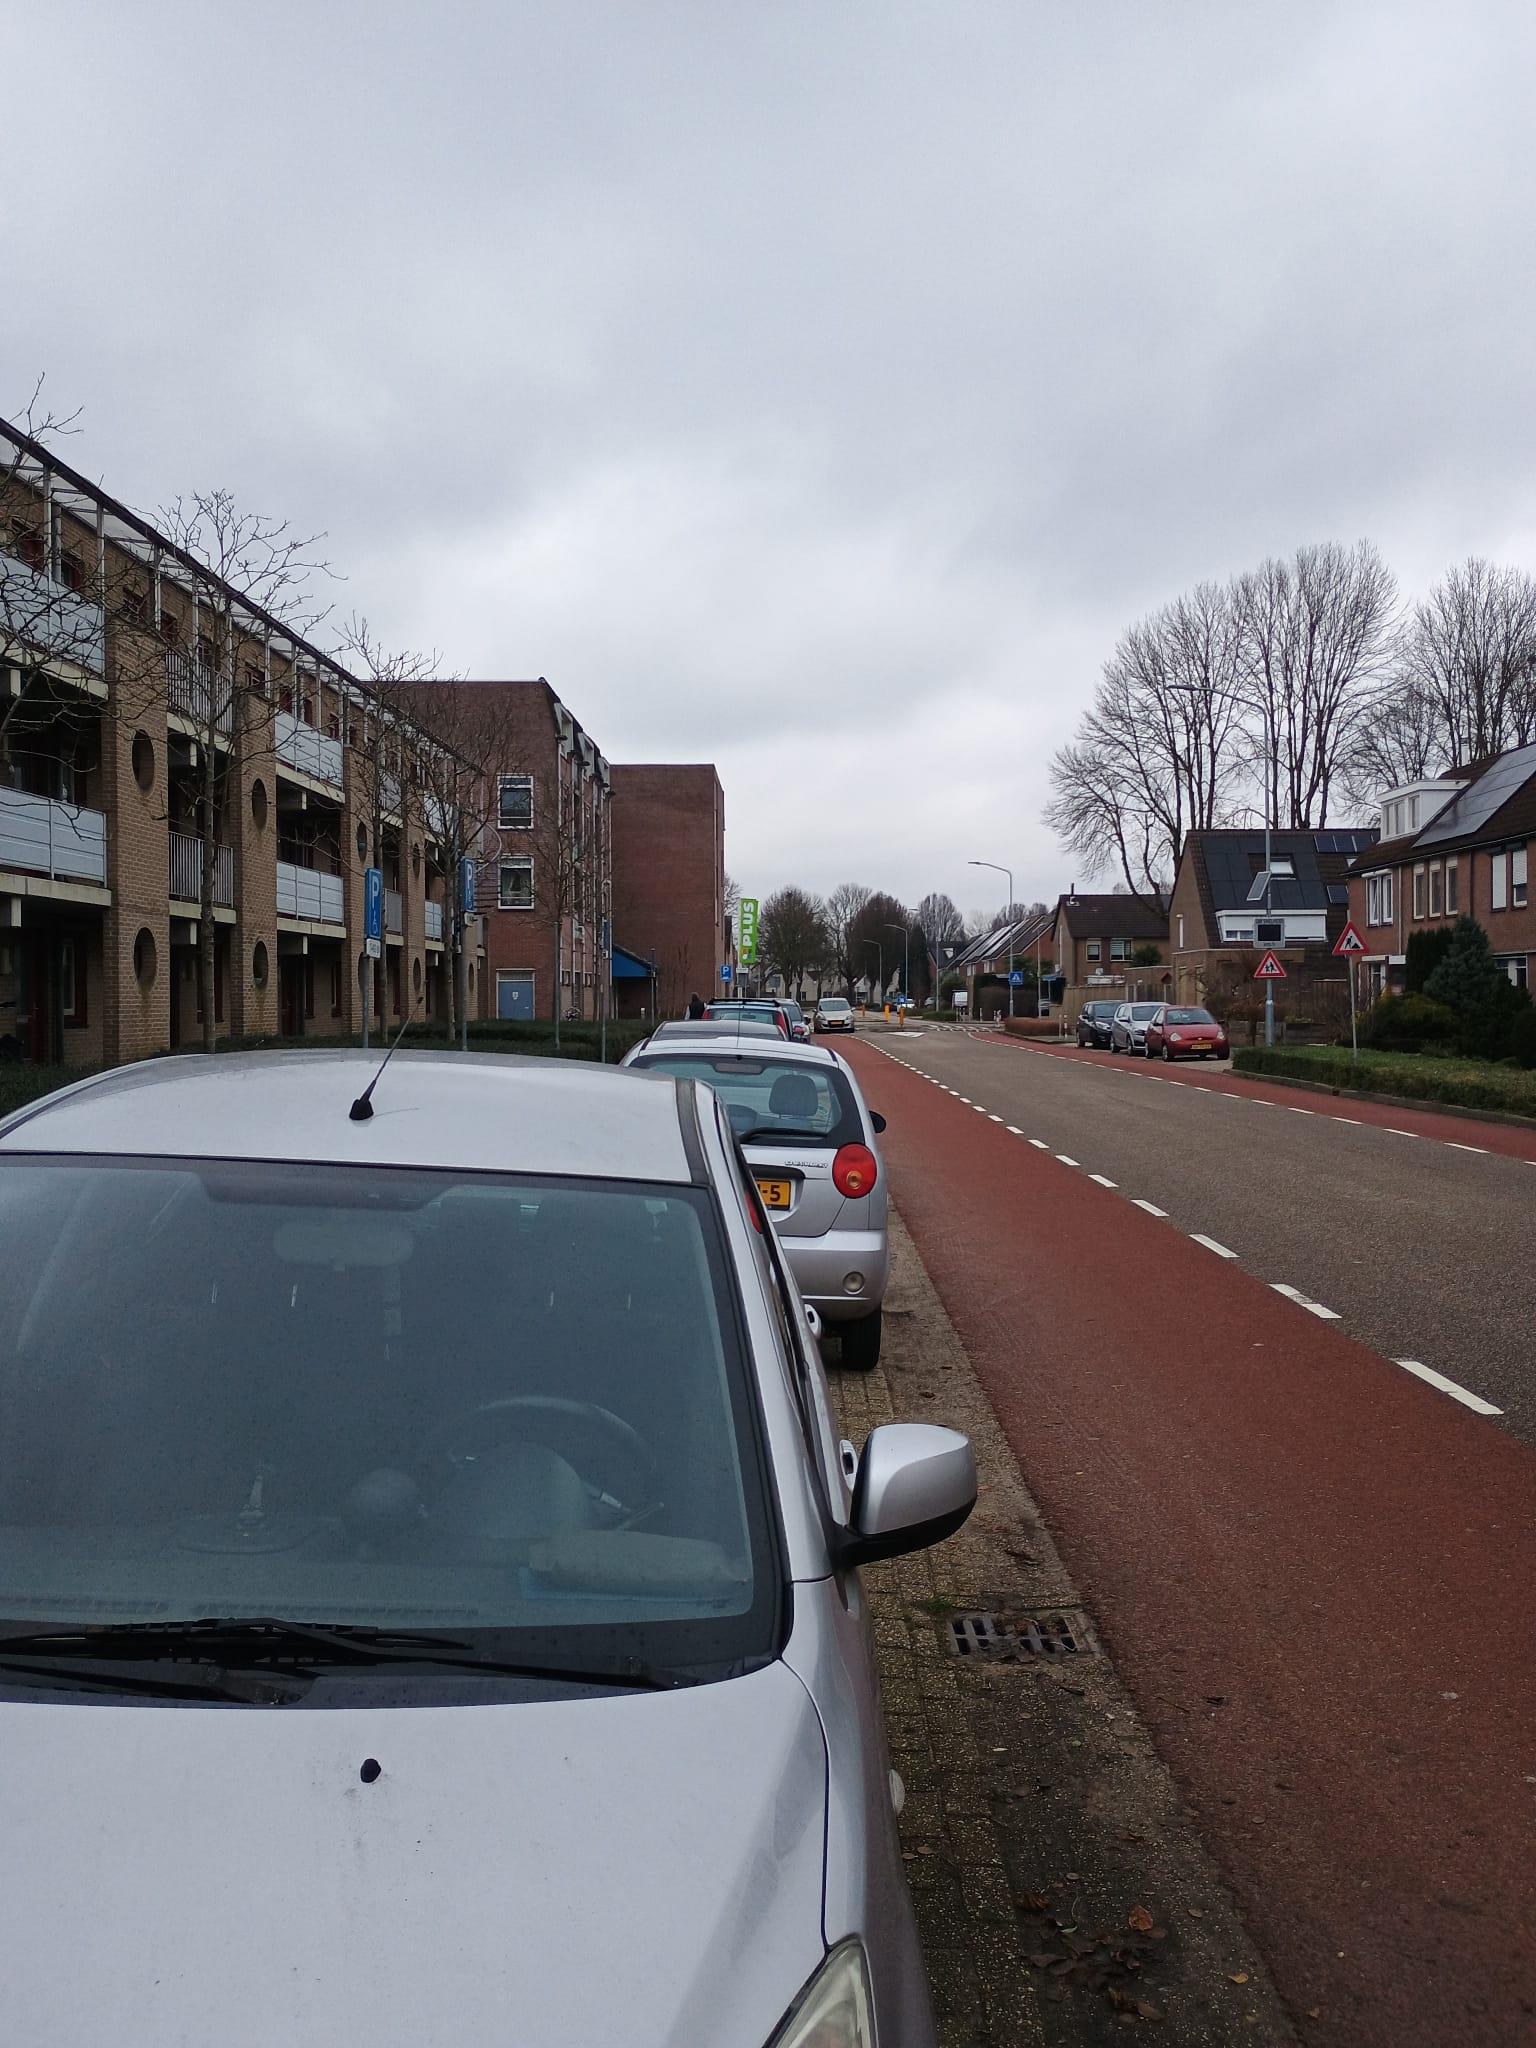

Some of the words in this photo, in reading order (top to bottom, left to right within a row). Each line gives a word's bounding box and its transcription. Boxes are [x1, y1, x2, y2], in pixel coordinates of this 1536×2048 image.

[467, 863, 473, 889] P
[371, 875, 380, 909] P
[742, 902, 754, 947] PLUS
[722, 966, 729, 975] P
